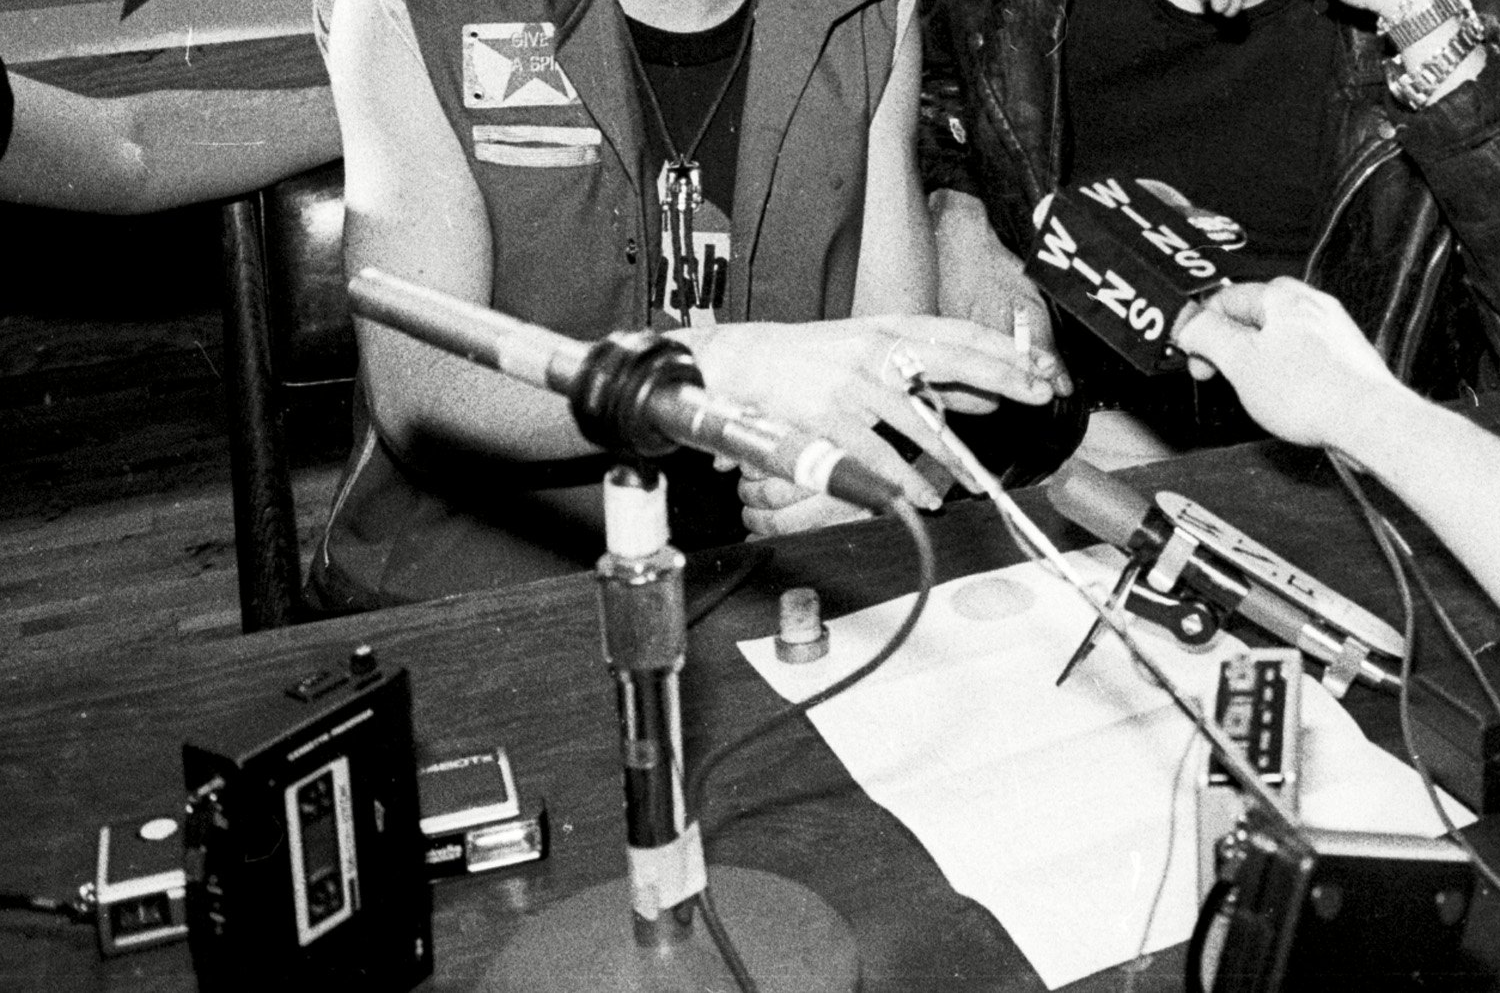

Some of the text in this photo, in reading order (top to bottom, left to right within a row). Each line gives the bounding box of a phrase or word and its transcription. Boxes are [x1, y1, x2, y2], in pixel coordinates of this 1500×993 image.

[511, 30, 550, 48] GIVE
[511, 55, 555, 73] A SPI
[1079, 177, 1217, 278] WINS
[1036, 215, 1165, 341] WINS
